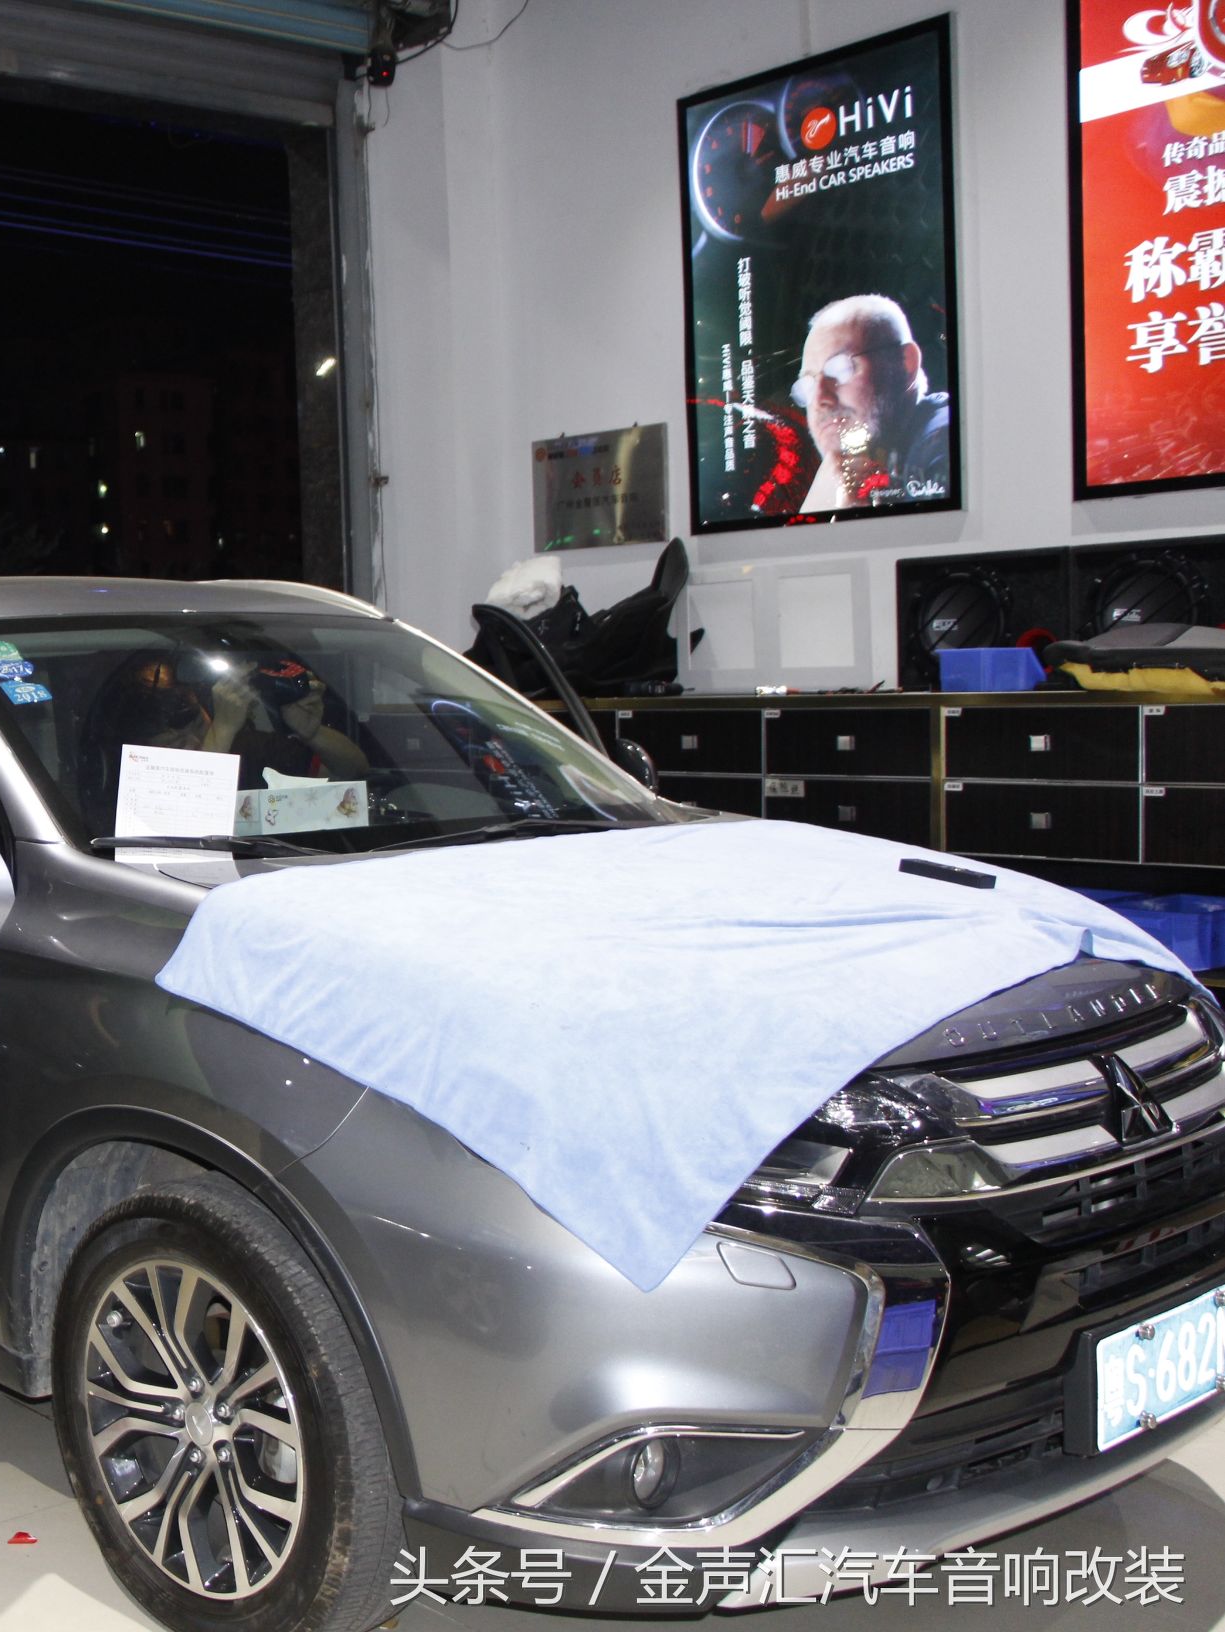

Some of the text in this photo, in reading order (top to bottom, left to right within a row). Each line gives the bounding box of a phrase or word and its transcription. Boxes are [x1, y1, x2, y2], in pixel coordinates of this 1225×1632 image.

[838, 86, 913, 136] HiVi
[775, 130, 916, 184] 惠威专业汽车音响
[776, 153, 915, 201] Hi-End CAR SPEAKERS
[1123, 227, 1225, 303] 称霸
[1125, 302, 1225, 373] 享誉
